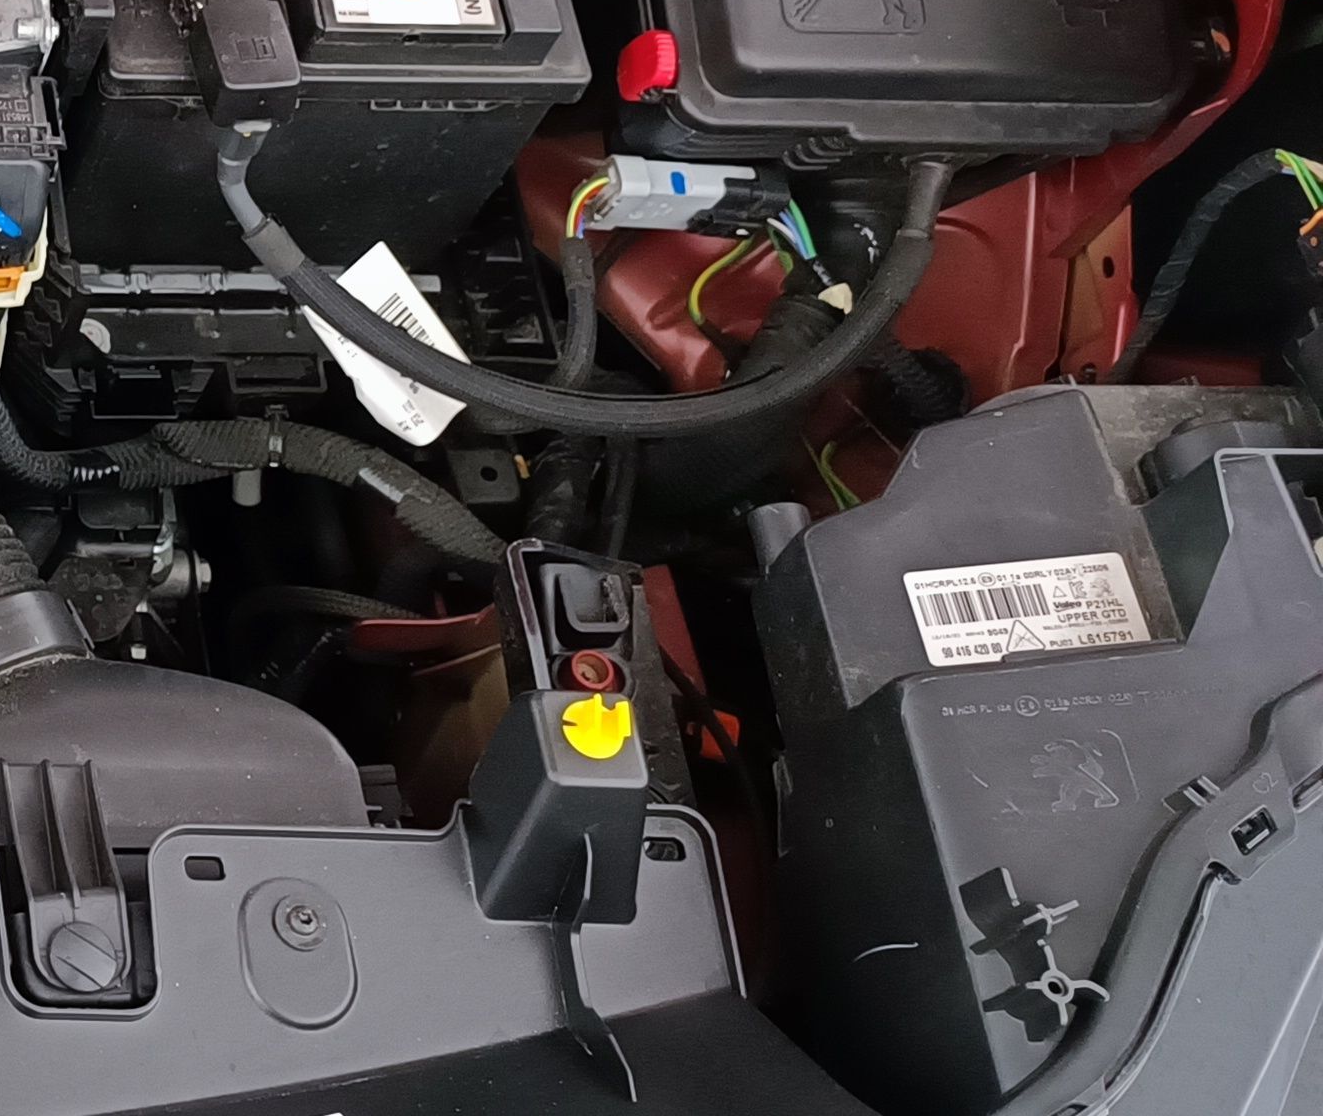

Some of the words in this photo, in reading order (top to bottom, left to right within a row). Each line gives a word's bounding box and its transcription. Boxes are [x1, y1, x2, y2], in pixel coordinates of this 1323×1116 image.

[1086, 598, 1124, 609] P21HL
[1058, 612, 1098, 624] UPPER
[1101, 609, 1127, 619] GTD
[1079, 631, 1134, 645] L615791
